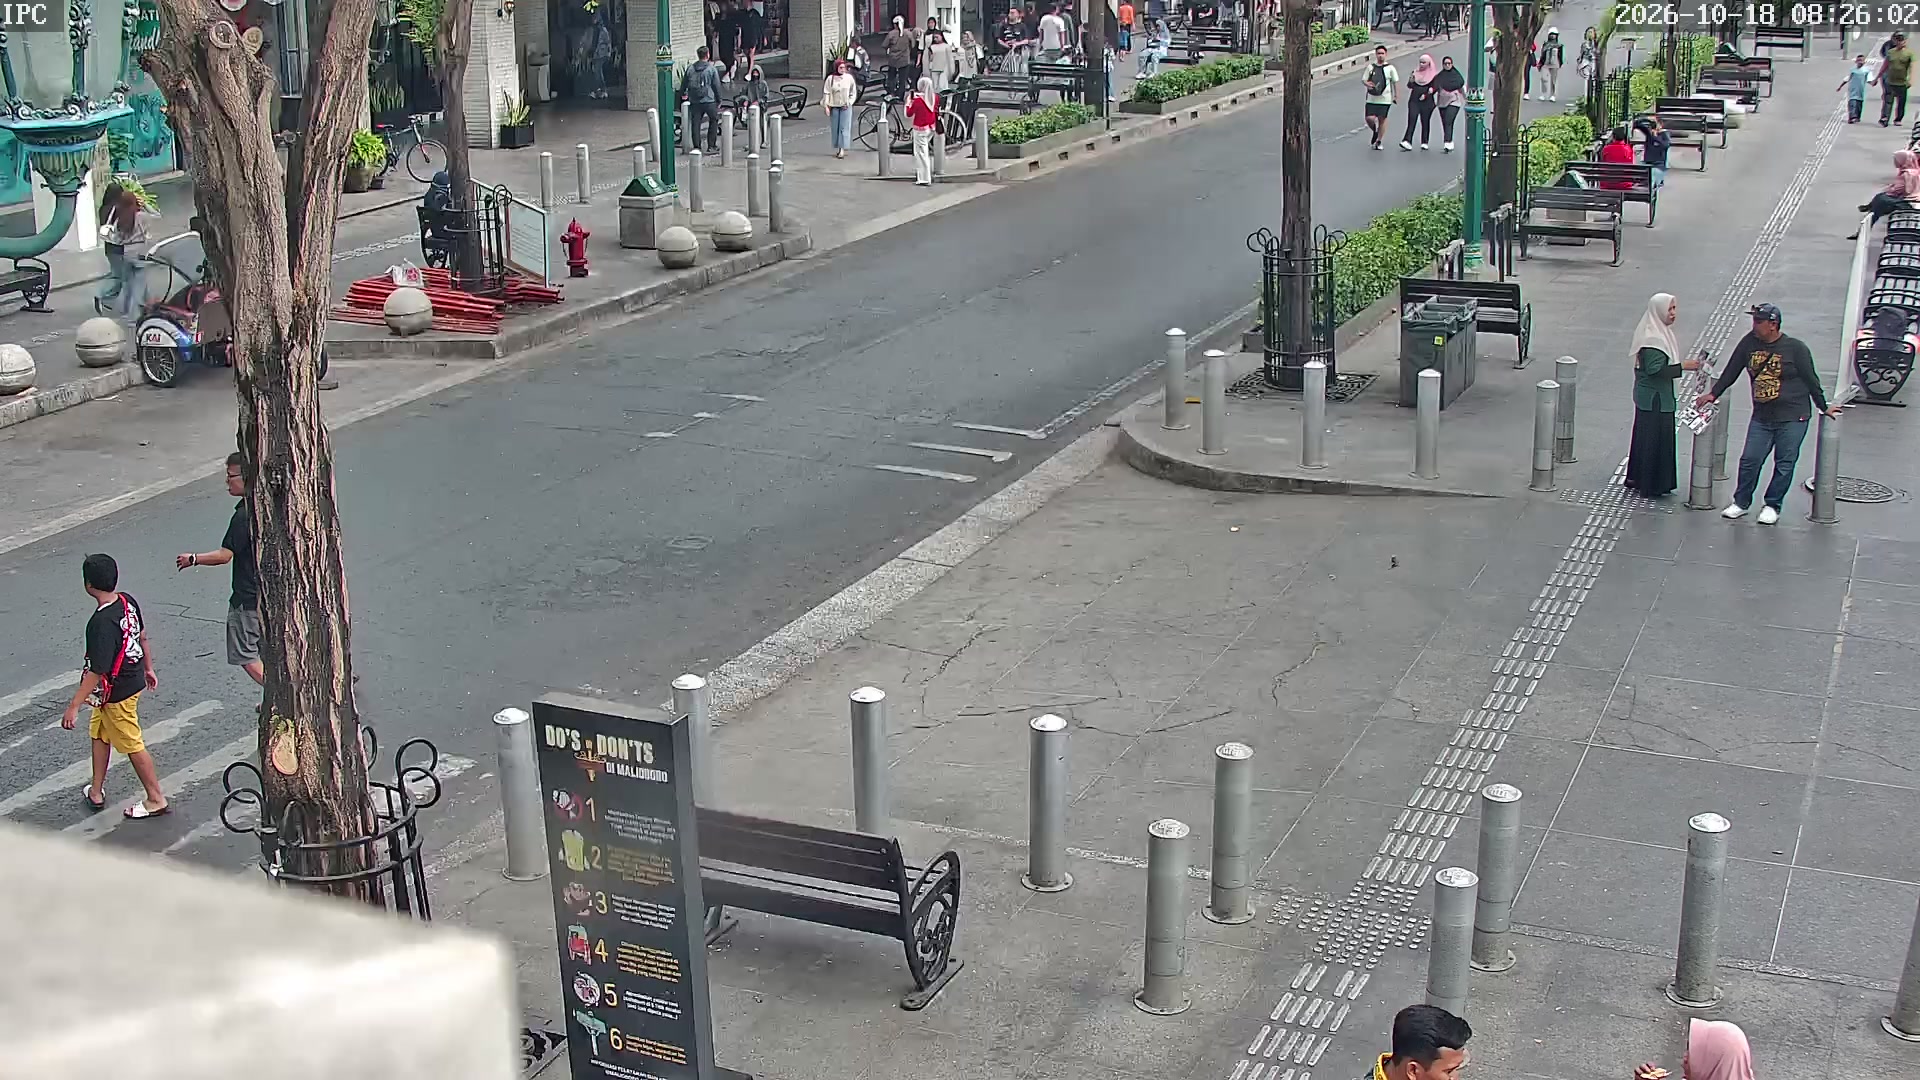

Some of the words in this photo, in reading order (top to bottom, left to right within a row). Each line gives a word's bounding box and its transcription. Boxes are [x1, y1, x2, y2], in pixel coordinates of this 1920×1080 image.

[545, 724, 582, 751] DO'S
[596, 734, 654, 764] DON'TS
[586, 797, 596, 822] 1
[591, 846, 602, 870] 2
[595, 891, 608, 914] 3
[595, 938, 608, 963] 4
[604, 983, 618, 1007] 5
[609, 1027, 623, 1051] 6
